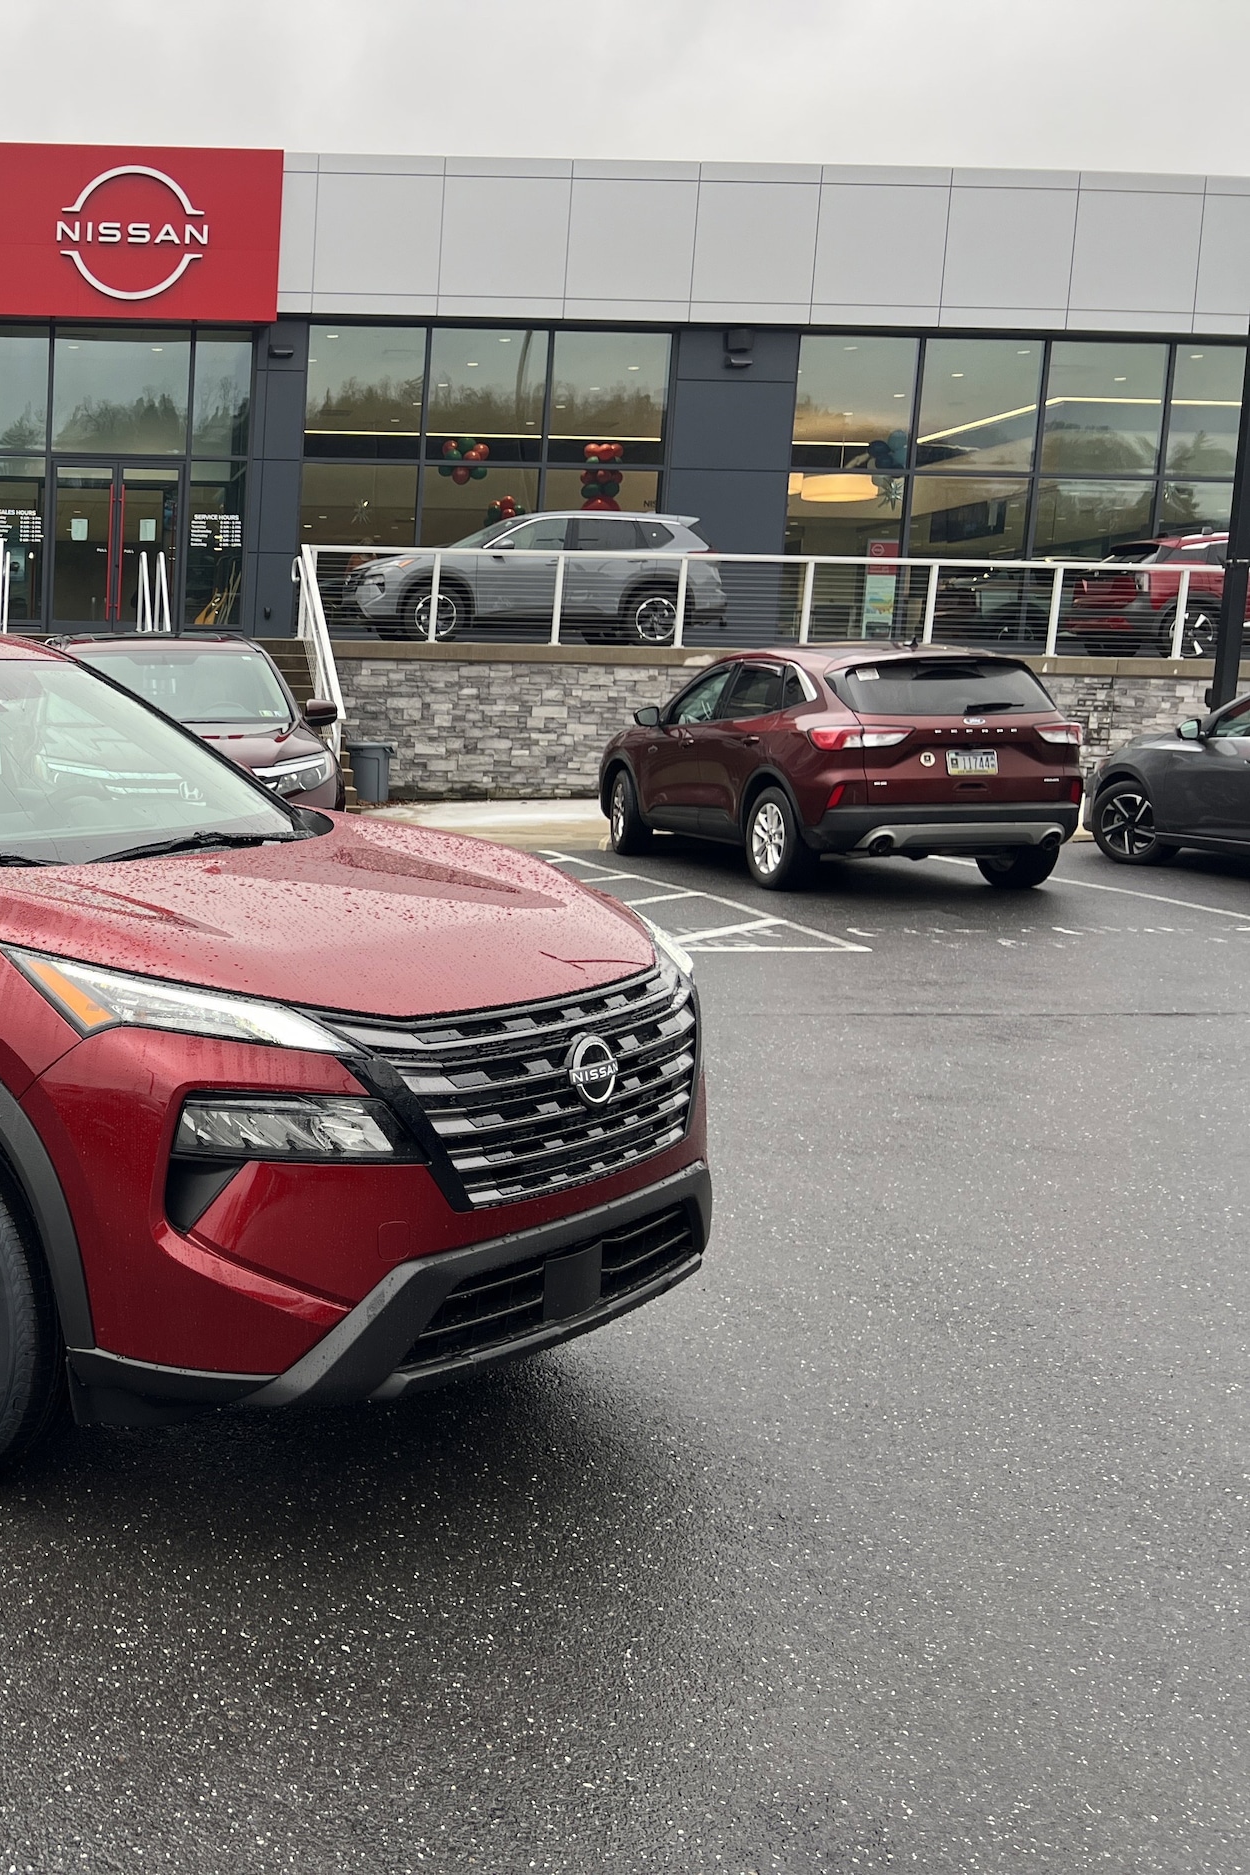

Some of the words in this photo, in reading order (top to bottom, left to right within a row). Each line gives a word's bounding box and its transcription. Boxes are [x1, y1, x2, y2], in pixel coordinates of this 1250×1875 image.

[56, 220, 209, 245] NISSAN
[193, 513, 218, 521] SERVICE
[572, 1060, 619, 1083] NISSAN
